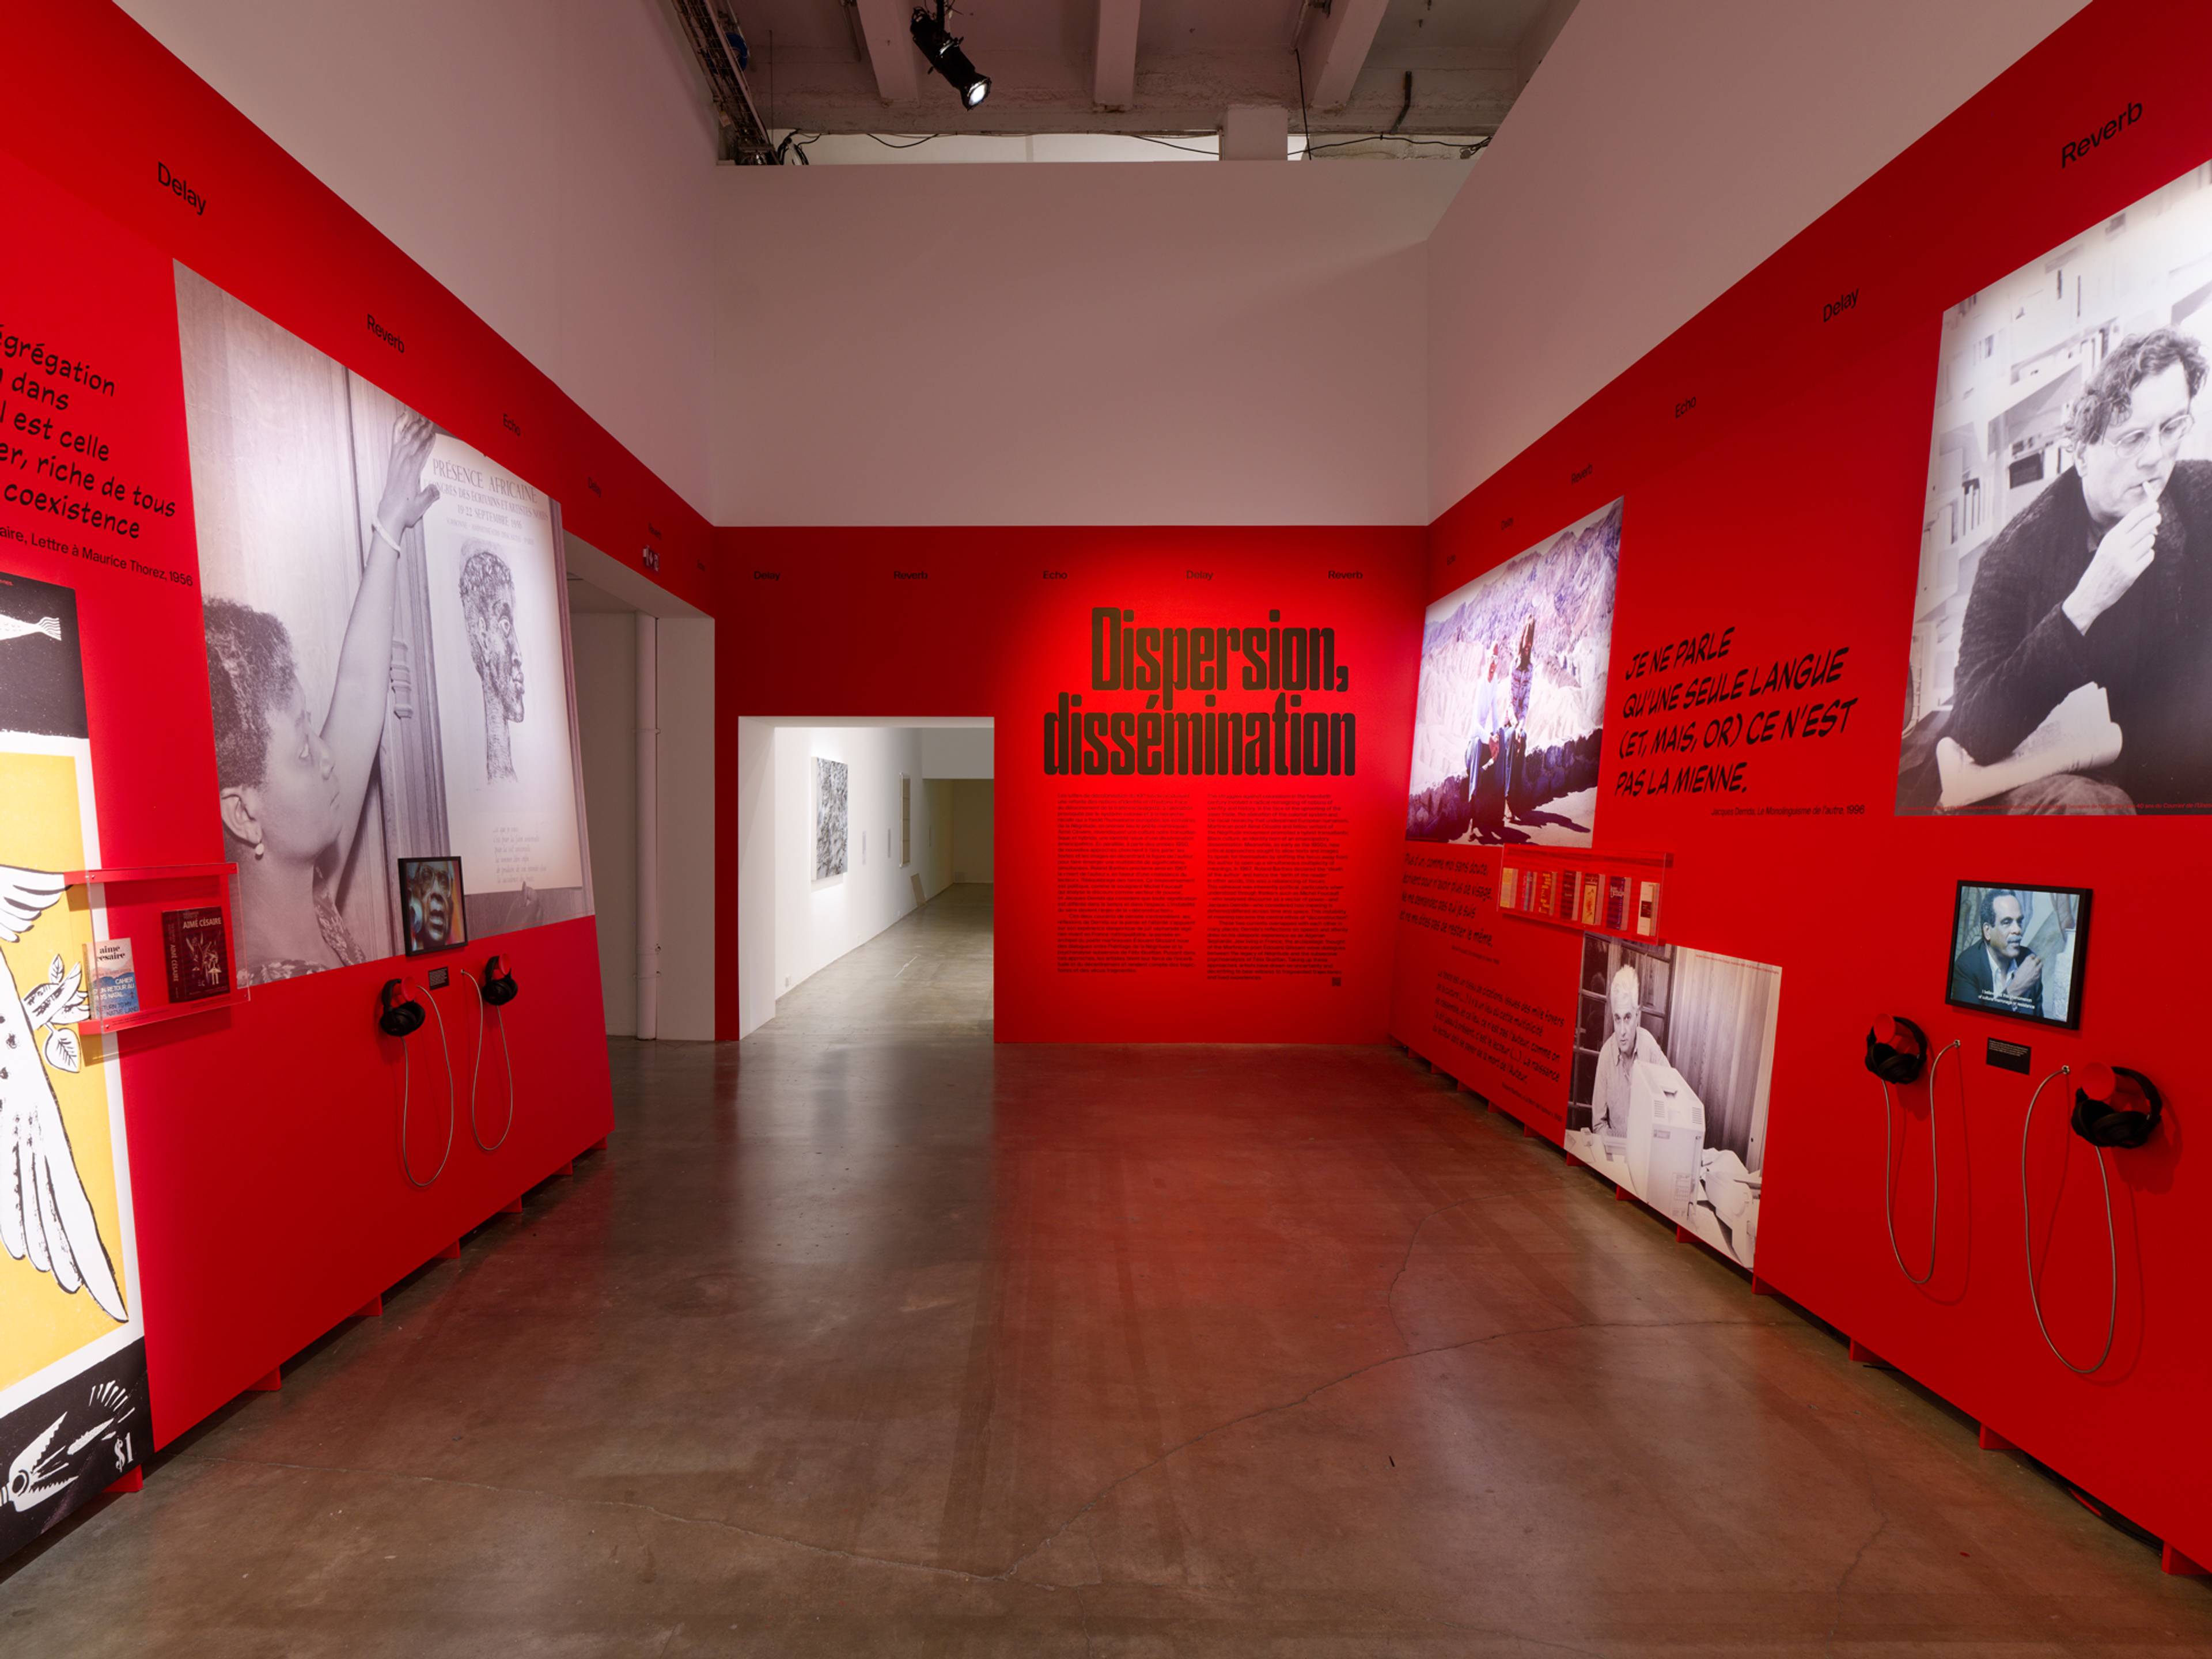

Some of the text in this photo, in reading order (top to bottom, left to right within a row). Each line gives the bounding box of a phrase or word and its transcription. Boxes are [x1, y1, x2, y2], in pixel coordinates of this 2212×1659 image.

[2062, 102, 2143, 169] Reverb
[158, 161, 207, 216] Delay
[1823, 289, 1859, 323] Delay
[367, 313, 405, 354] Reverb
[12, 372, 69, 410] dans
[1675, 396, 1696, 419] Echo
[14, 412, 54, 440] est
[59, 430, 109, 461] celle
[503, 413, 521, 437] Echo
[37, 456, 94, 490] riche
[102, 476, 126, 501] de
[133, 486, 176, 517] tous
[433, 458, 538, 504] PRÉSENCE AFRICAINE
[588, 476, 601, 498] Delay
[1571, 463, 1593, 484] Reverb
[4, 483, 141, 539] coexistence
[31, 533, 69, 554] Lettre
[71, 544, 79, 556] à
[82, 547, 127, 570] Maurice
[130, 560, 168, 581] Thorez,
[169, 570, 194, 587] 1956
[753, 570, 781, 581] Delay
[893, 570, 928, 579] Reverb
[1043, 570, 1068, 580] Echo
[1186, 570, 1214, 581] Delay
[1328, 570, 1363, 579] Reverb
[1092, 607, 1349, 711] Dispersion,
[1626, 626, 1735, 681] JE NE PARLE
[1623, 646, 1849, 719] QU'UNE SEULE LANGUE
[1043, 691, 1356, 777] dissémination
[1619, 697, 1859, 759] (ET, MAIS, OR) CE N'EST
[1614, 762, 1748, 797] PAS LA MIENNE.
[1711, 808, 1733, 817] Jacques
[1758, 807, 1765, 815] Le
[1812, 806, 1821, 815] de
[1846, 804, 1865, 815] 1996
[183, 916, 222, 929] AIMÉ CÉSAIRE
[114, 1432, 134, 1473] $1
